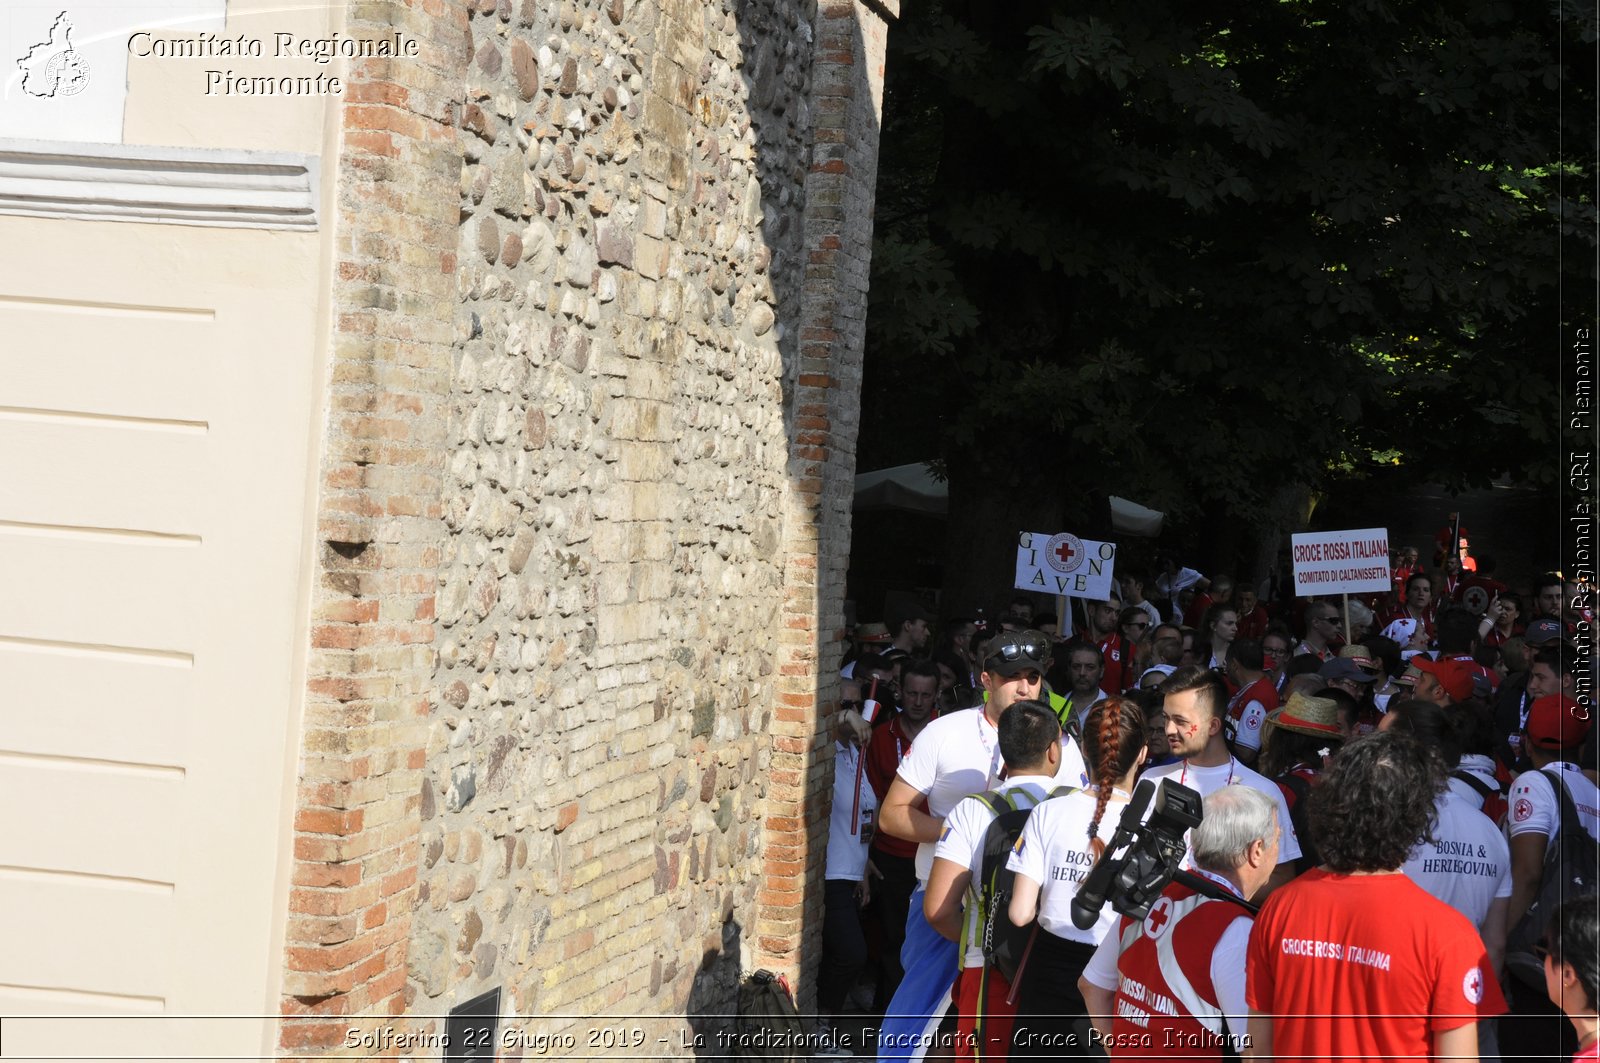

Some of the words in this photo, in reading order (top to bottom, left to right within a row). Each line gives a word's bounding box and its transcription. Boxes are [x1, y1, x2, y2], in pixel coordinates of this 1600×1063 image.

[1294, 544, 1322, 562] CROCE
[1323, 542, 1351, 561] ROSSA
[1352, 539, 1389, 559] ITALIANA
[1298, 570, 1330, 584] COMITATO
[1331, 570, 1338, 582] DI
[1339, 566, 1388, 581] CALTANISSETTA
[1065, 849, 1094, 867] BOS
[1436, 840, 1474, 857] BOSNIA
[1477, 844, 1487, 858] &
[1422, 858, 1498, 878] HERZEGOVINA
[1281, 938, 1314, 957] CROCE
[1347, 945, 1391, 971] ITALIANA
